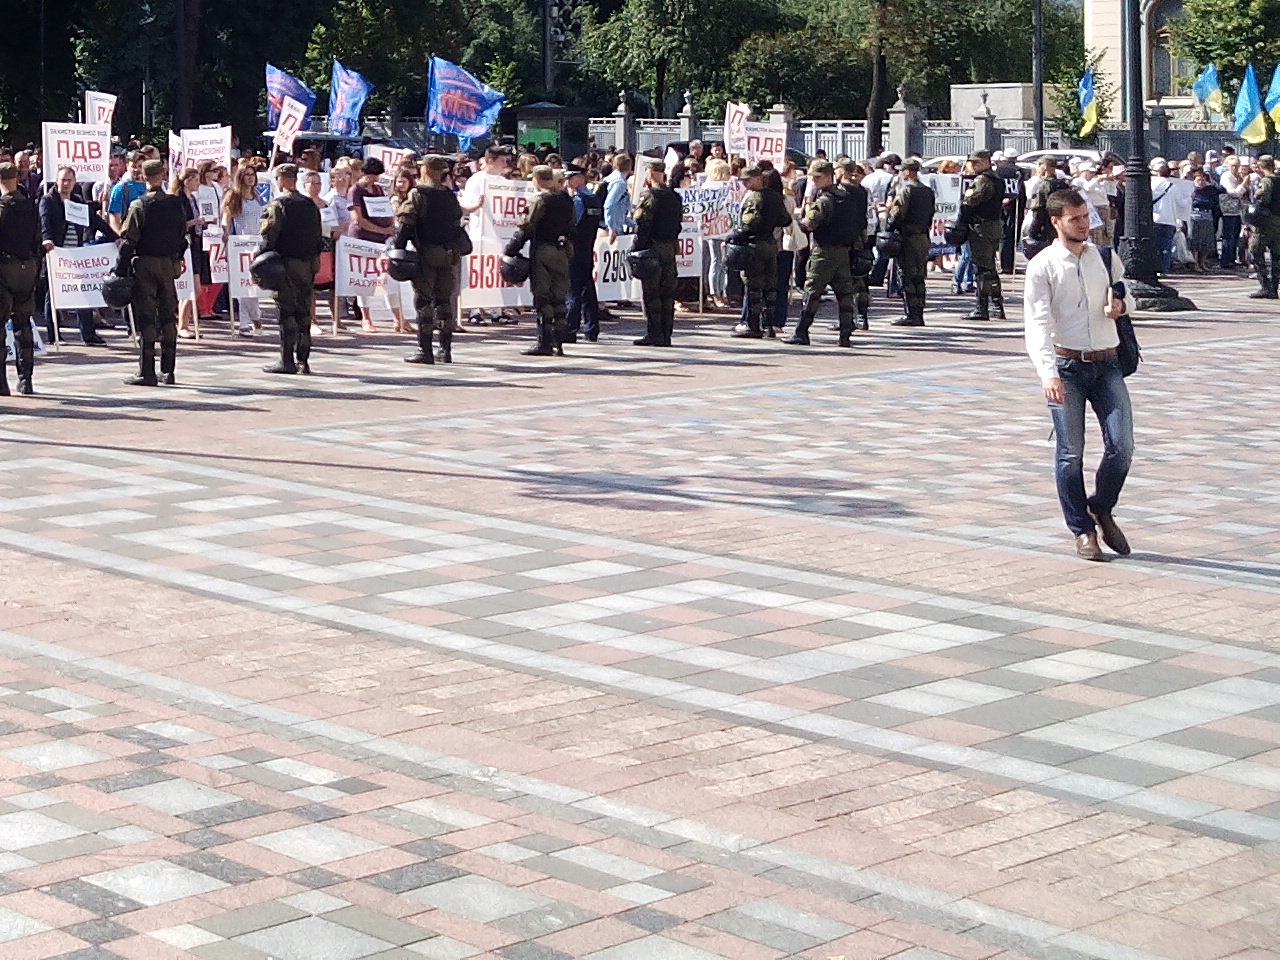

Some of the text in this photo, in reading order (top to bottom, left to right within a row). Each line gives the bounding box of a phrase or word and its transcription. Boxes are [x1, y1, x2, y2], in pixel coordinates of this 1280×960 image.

[57, 140, 102, 162] ПДВ
[748, 136, 783, 155] ПДВ
[493, 196, 527, 218] ПДВ
